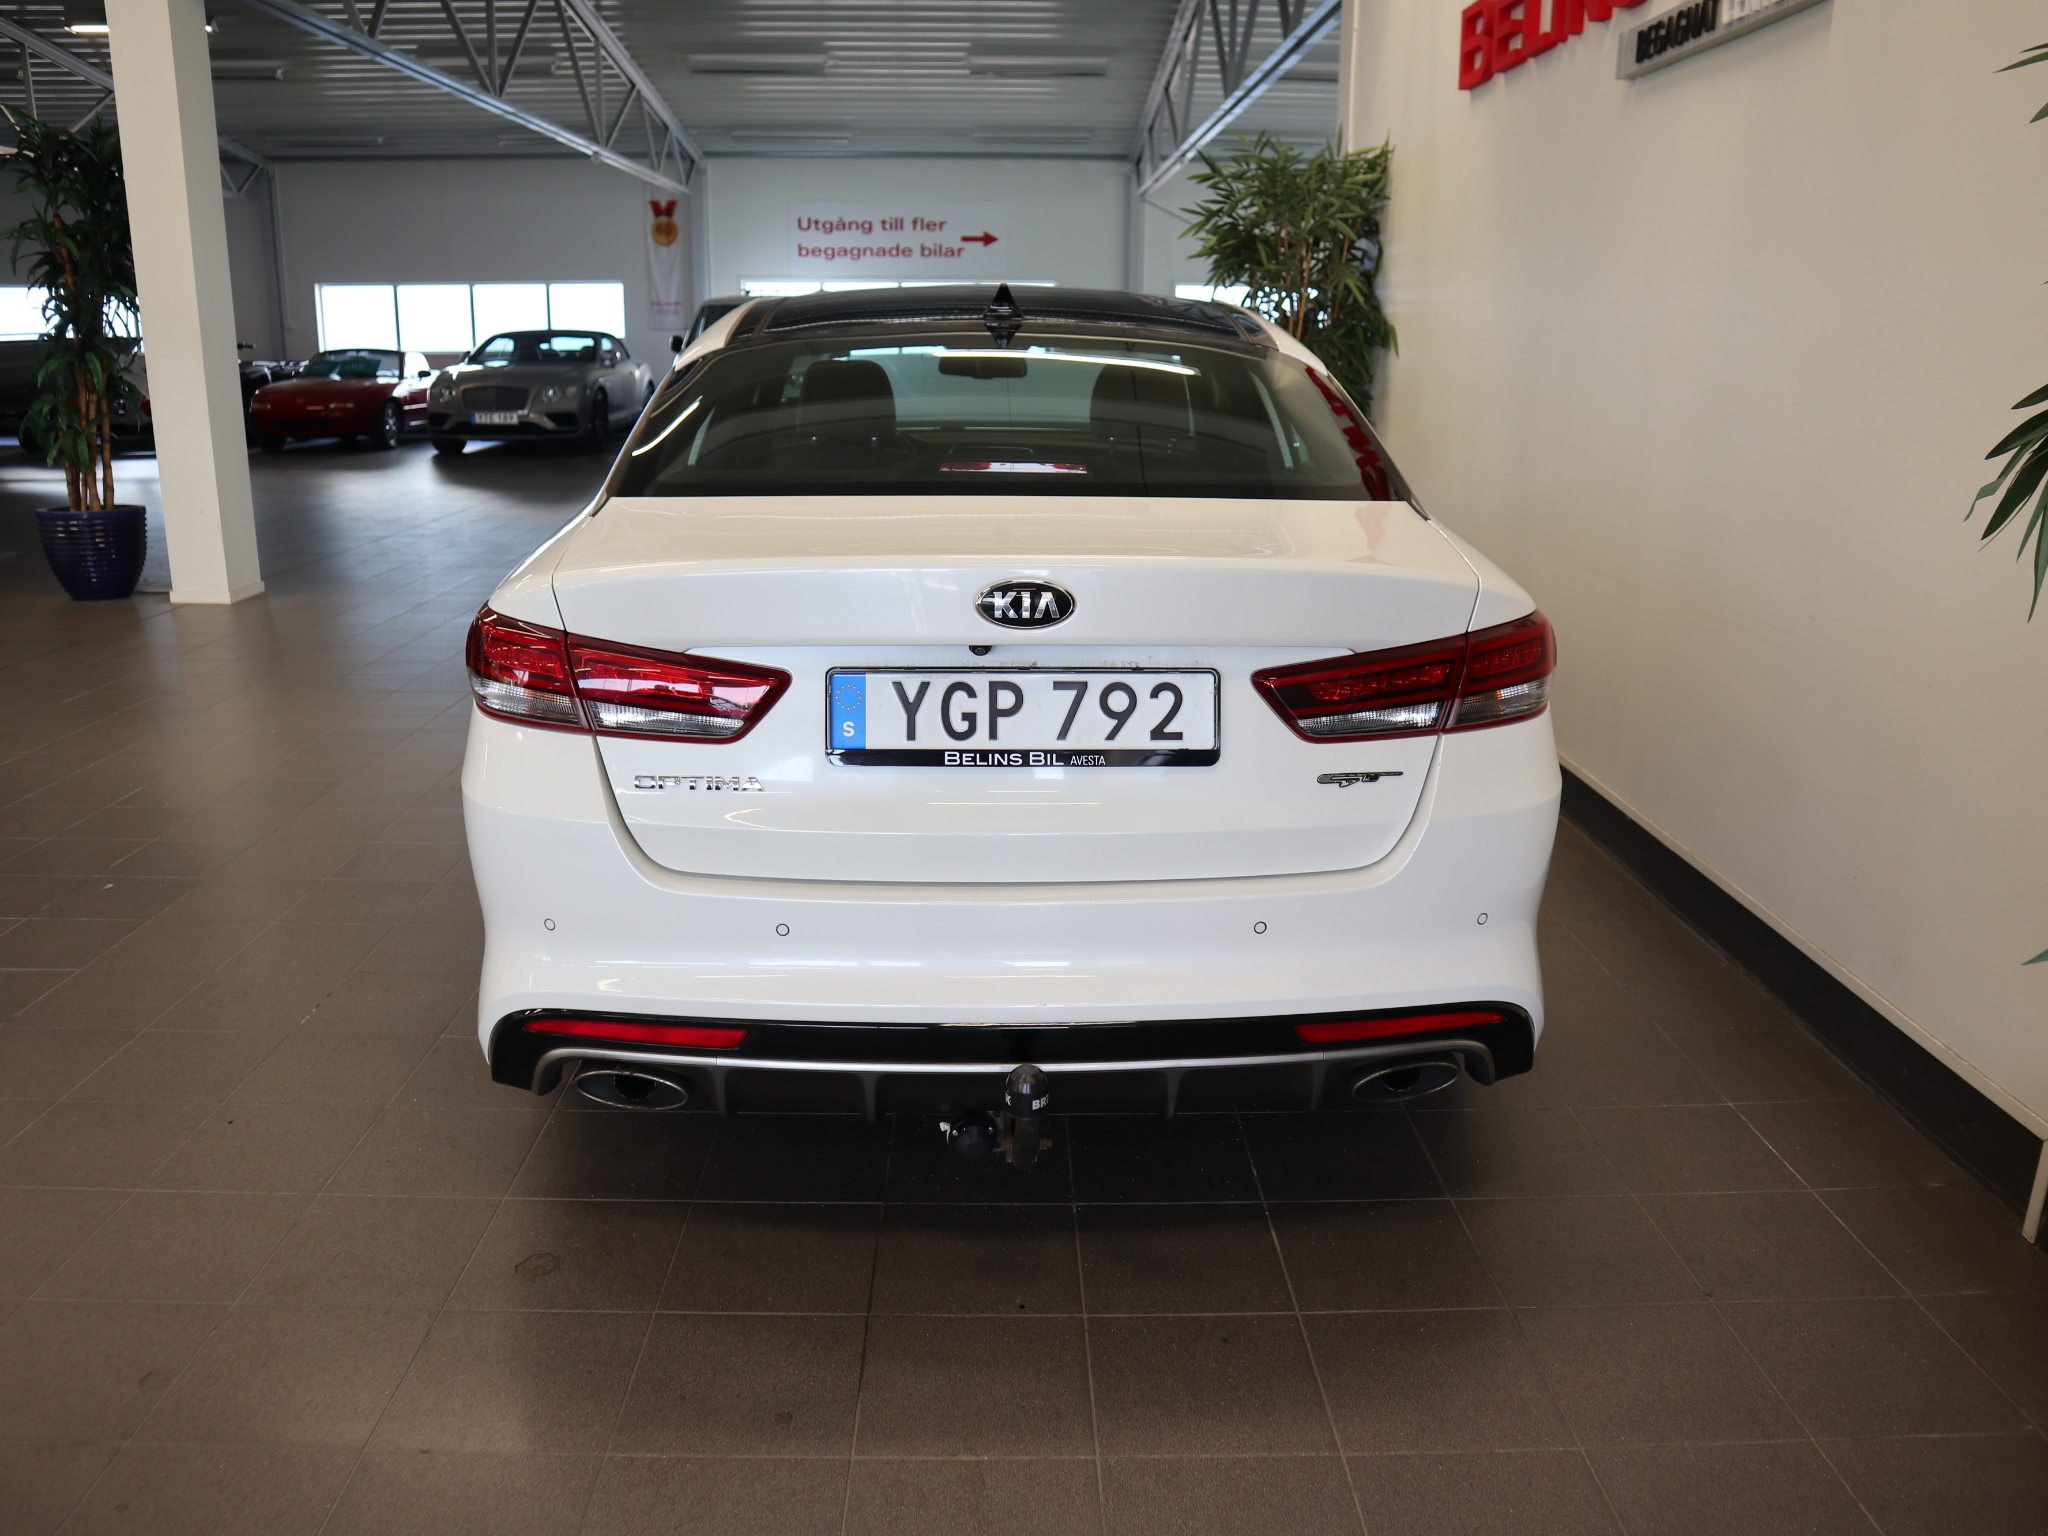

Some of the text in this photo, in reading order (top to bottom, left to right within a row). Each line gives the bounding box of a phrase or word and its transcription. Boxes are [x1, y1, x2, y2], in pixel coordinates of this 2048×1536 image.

[1635, 0, 1718, 64] BEGAGNAT
[1459, 0, 1650, 90] BELIN
[797, 216, 947, 235] Utgång till fler
[798, 243, 965, 260] begagnade bilar
[993, 591, 1060, 619] KIA
[891, 681, 1184, 742] YGP 792
[842, 720, 856, 738] S
[944, 751, 1106, 766] BELINS BIL AVESTA
[634, 775, 765, 791] OPTIMA
